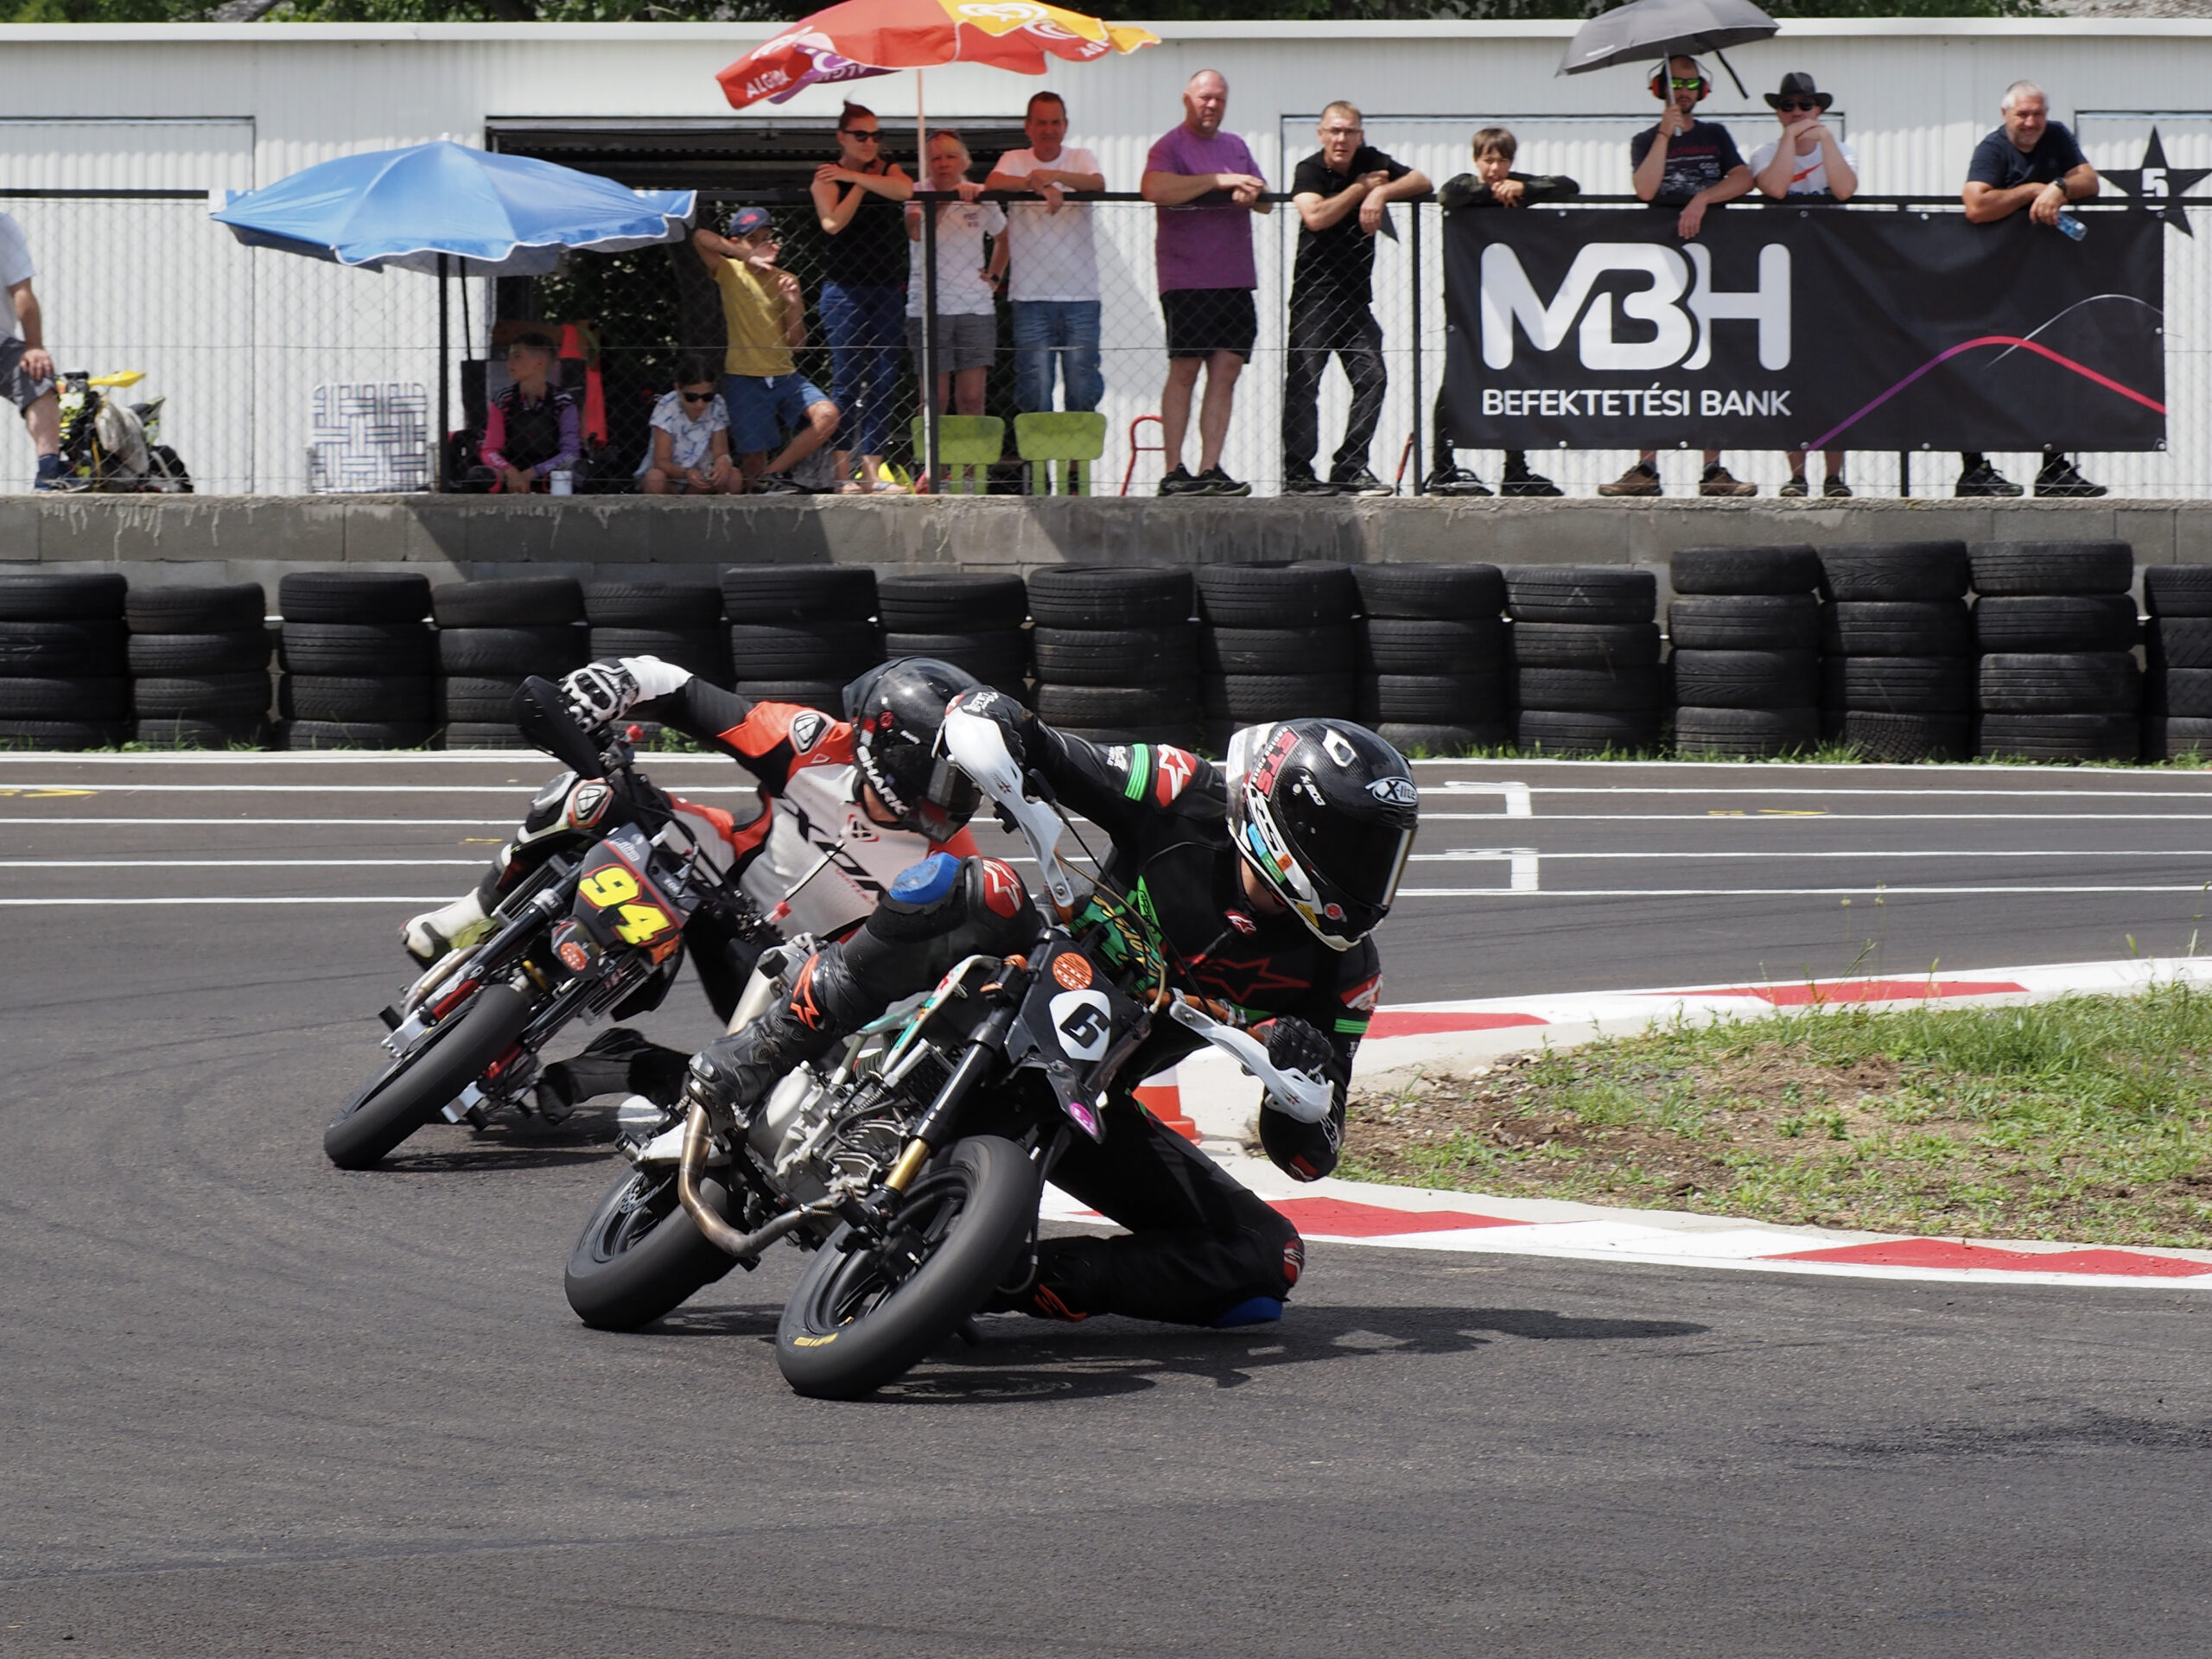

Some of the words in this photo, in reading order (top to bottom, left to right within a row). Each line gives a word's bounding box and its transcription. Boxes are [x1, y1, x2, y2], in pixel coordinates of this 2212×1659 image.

[2142, 168, 2169, 211] 5
[1482, 382, 1691, 416] BEFEKTETÉSI
[1700, 389, 1792, 416] BANK
[856, 745, 911, 816] SHARK
[1382, 780, 1417, 801] X-lite
[578, 867, 671, 944] 94
[1059, 1002, 1111, 1049] 6
